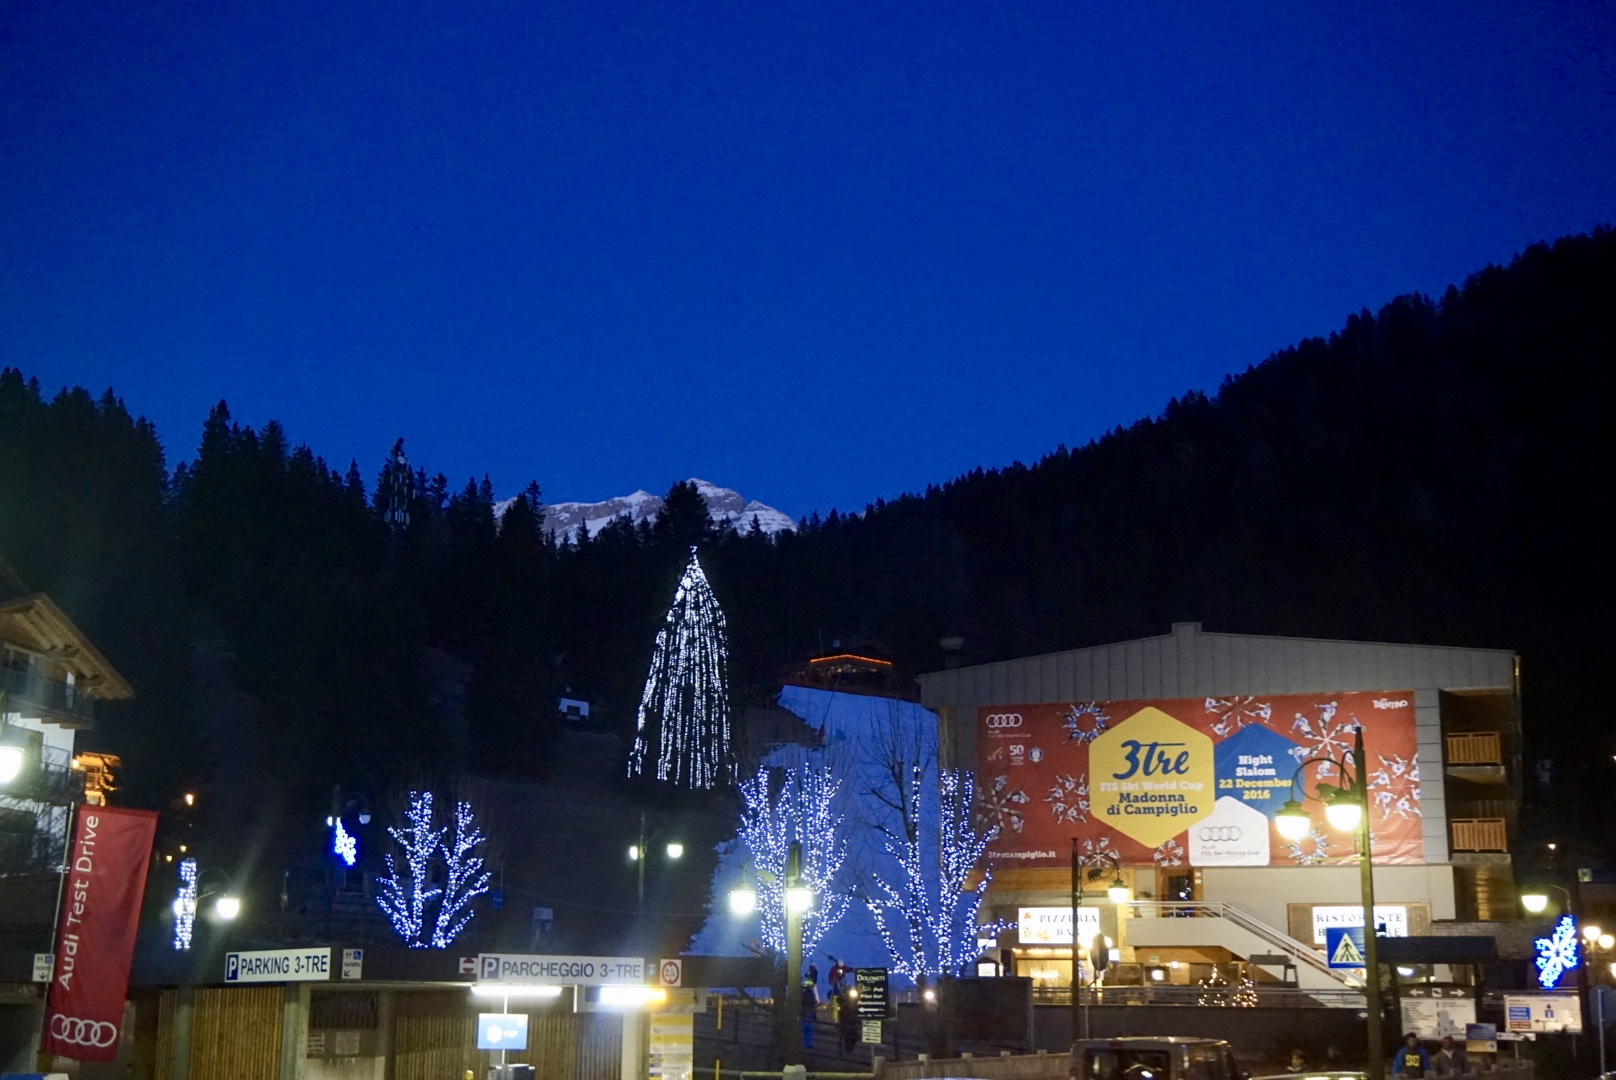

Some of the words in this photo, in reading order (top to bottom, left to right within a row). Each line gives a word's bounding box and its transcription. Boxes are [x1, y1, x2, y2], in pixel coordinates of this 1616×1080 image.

[1009, 745, 1024, 755] 50
[1238, 755, 1273, 766] Night
[1236, 767, 1276, 777] Slalom
[1100, 782, 1118, 791] FIS
[1121, 782, 1139, 791] Ski
[1142, 782, 1177, 790] World
[1180, 781, 1204, 791] Cup
[1219, 779, 1233, 788] 22
[1236, 778, 1292, 788] December
[1119, 792, 1185, 803] Madonna
[1243, 790, 1271, 799] 2016
[1107, 805, 1121, 815] di
[1124, 804, 1198, 817] Campiglio
[76, 815, 98, 872] Drive
[67, 881, 89, 926] Test
[1040, 915, 1097, 923] PIZZERIA
[1317, 914, 1403, 922] RISTORNTE
[58, 934, 79, 991] Audi
[241, 957, 289, 975] PARKING
[295, 955, 328, 973] 3-TRE
[502, 961, 594, 978] PARCHEGGIO
[600, 963, 641, 978] 3-TRE
